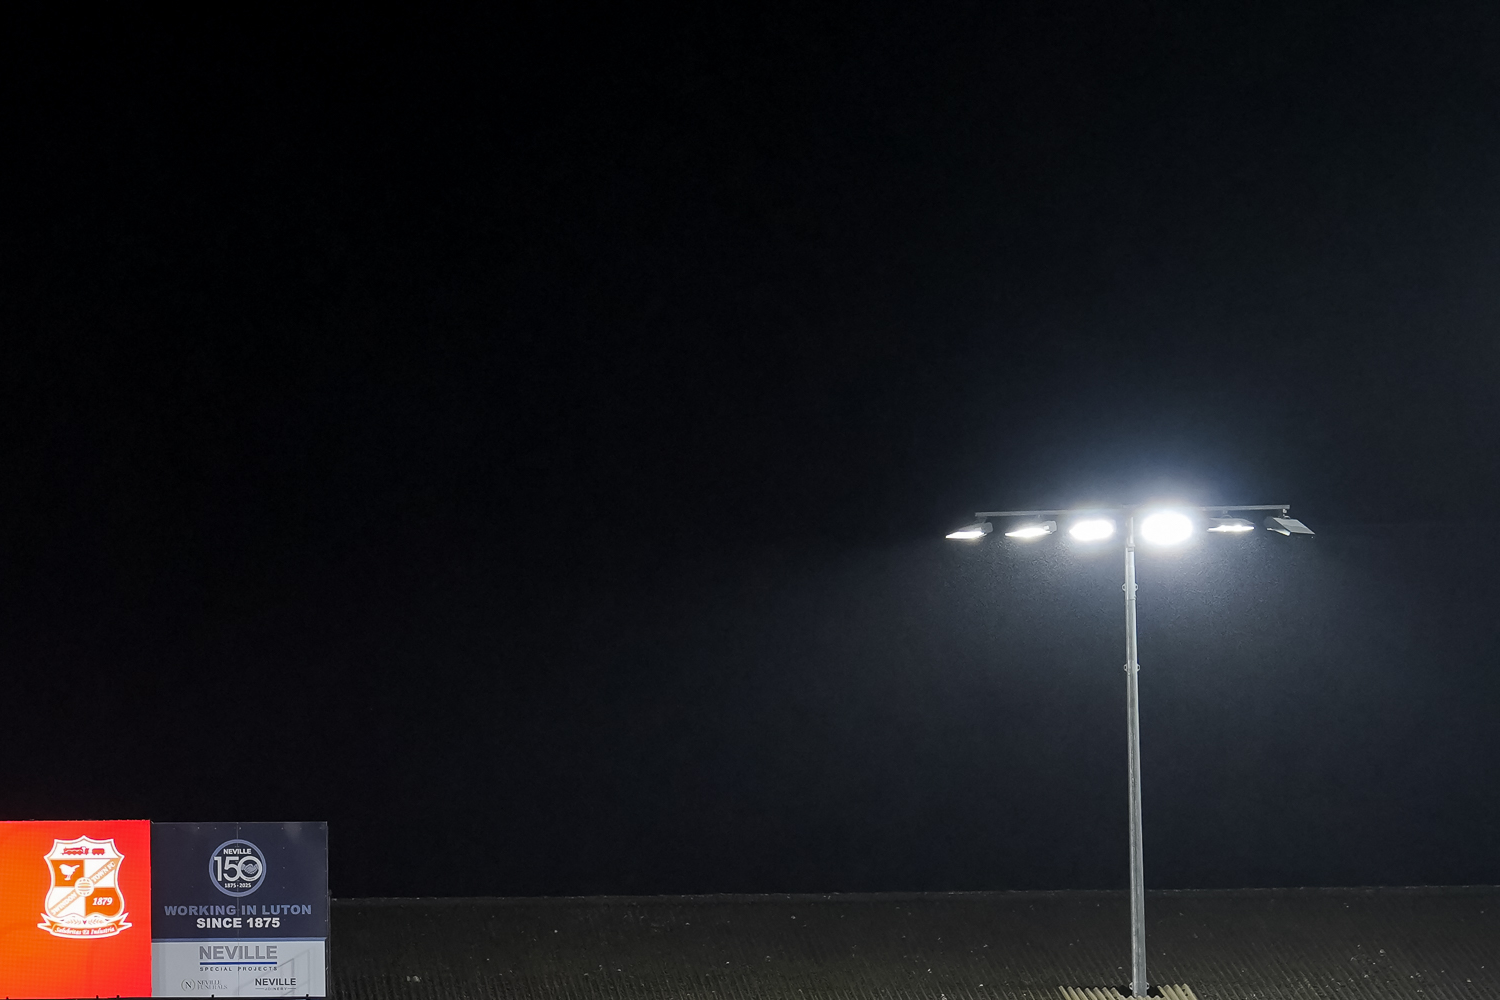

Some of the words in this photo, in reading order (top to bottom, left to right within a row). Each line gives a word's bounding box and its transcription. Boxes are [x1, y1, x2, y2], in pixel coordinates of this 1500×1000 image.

[213, 855, 263, 882] 150
[92, 897, 113, 906] 1879
[164, 905, 236, 916] WORKING
[241, 905, 257, 915] IN
[262, 904, 312, 915] LUTON
[196, 917, 242, 929] SINCE
[246, 917, 280, 928] 1875
[200, 945, 278, 960] NEVILLE
[255, 978, 296, 986] NEVILLE
